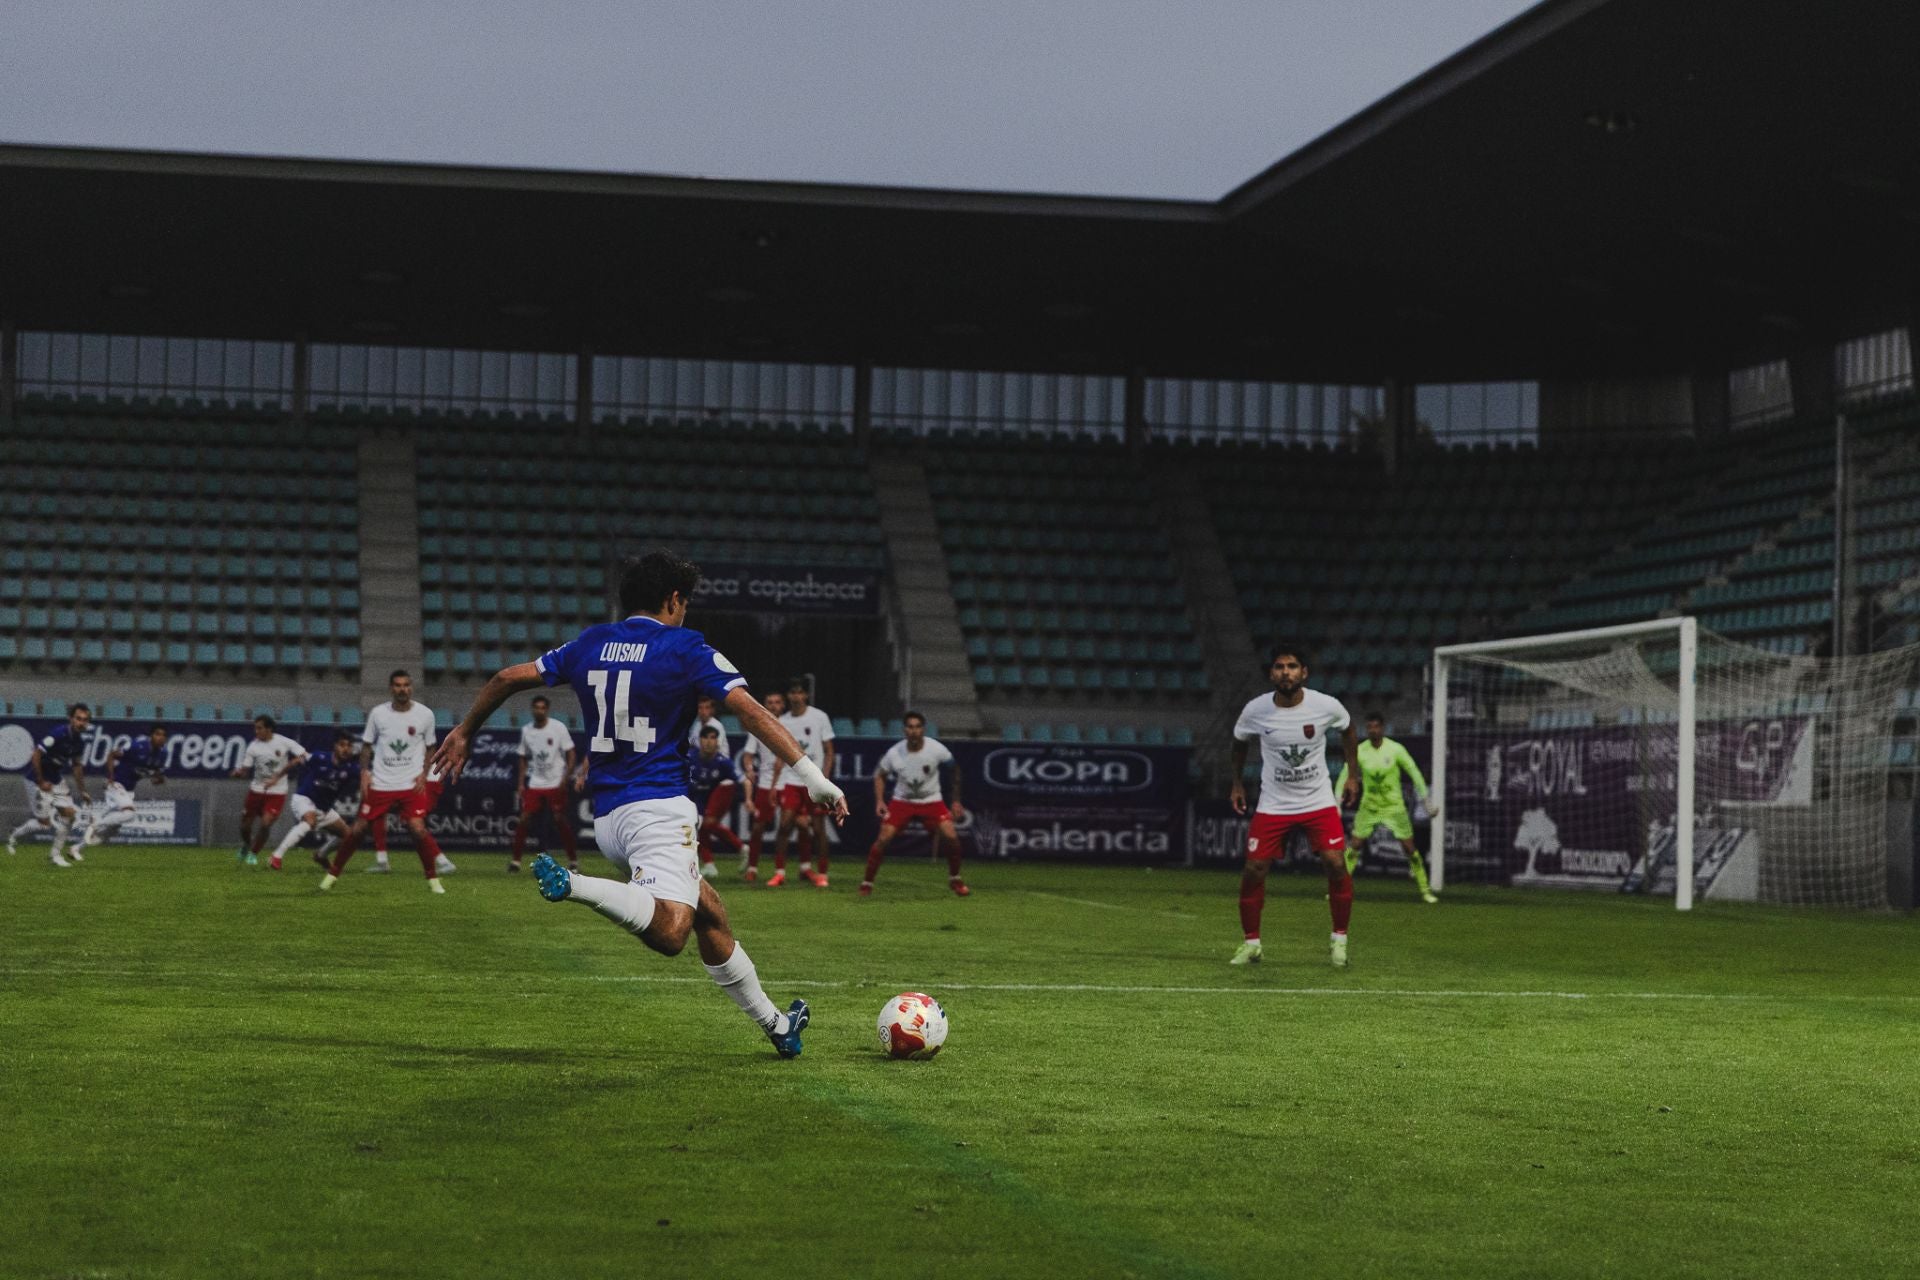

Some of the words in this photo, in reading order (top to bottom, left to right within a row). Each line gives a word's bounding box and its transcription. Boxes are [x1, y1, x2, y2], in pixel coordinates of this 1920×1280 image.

[599, 642, 648, 663] LUISMI
[587, 669, 657, 754] 14
[1008, 757, 1129, 783] KOPA
[1528, 739, 1588, 796] ROYAL
[998, 822, 1169, 856] palencia
